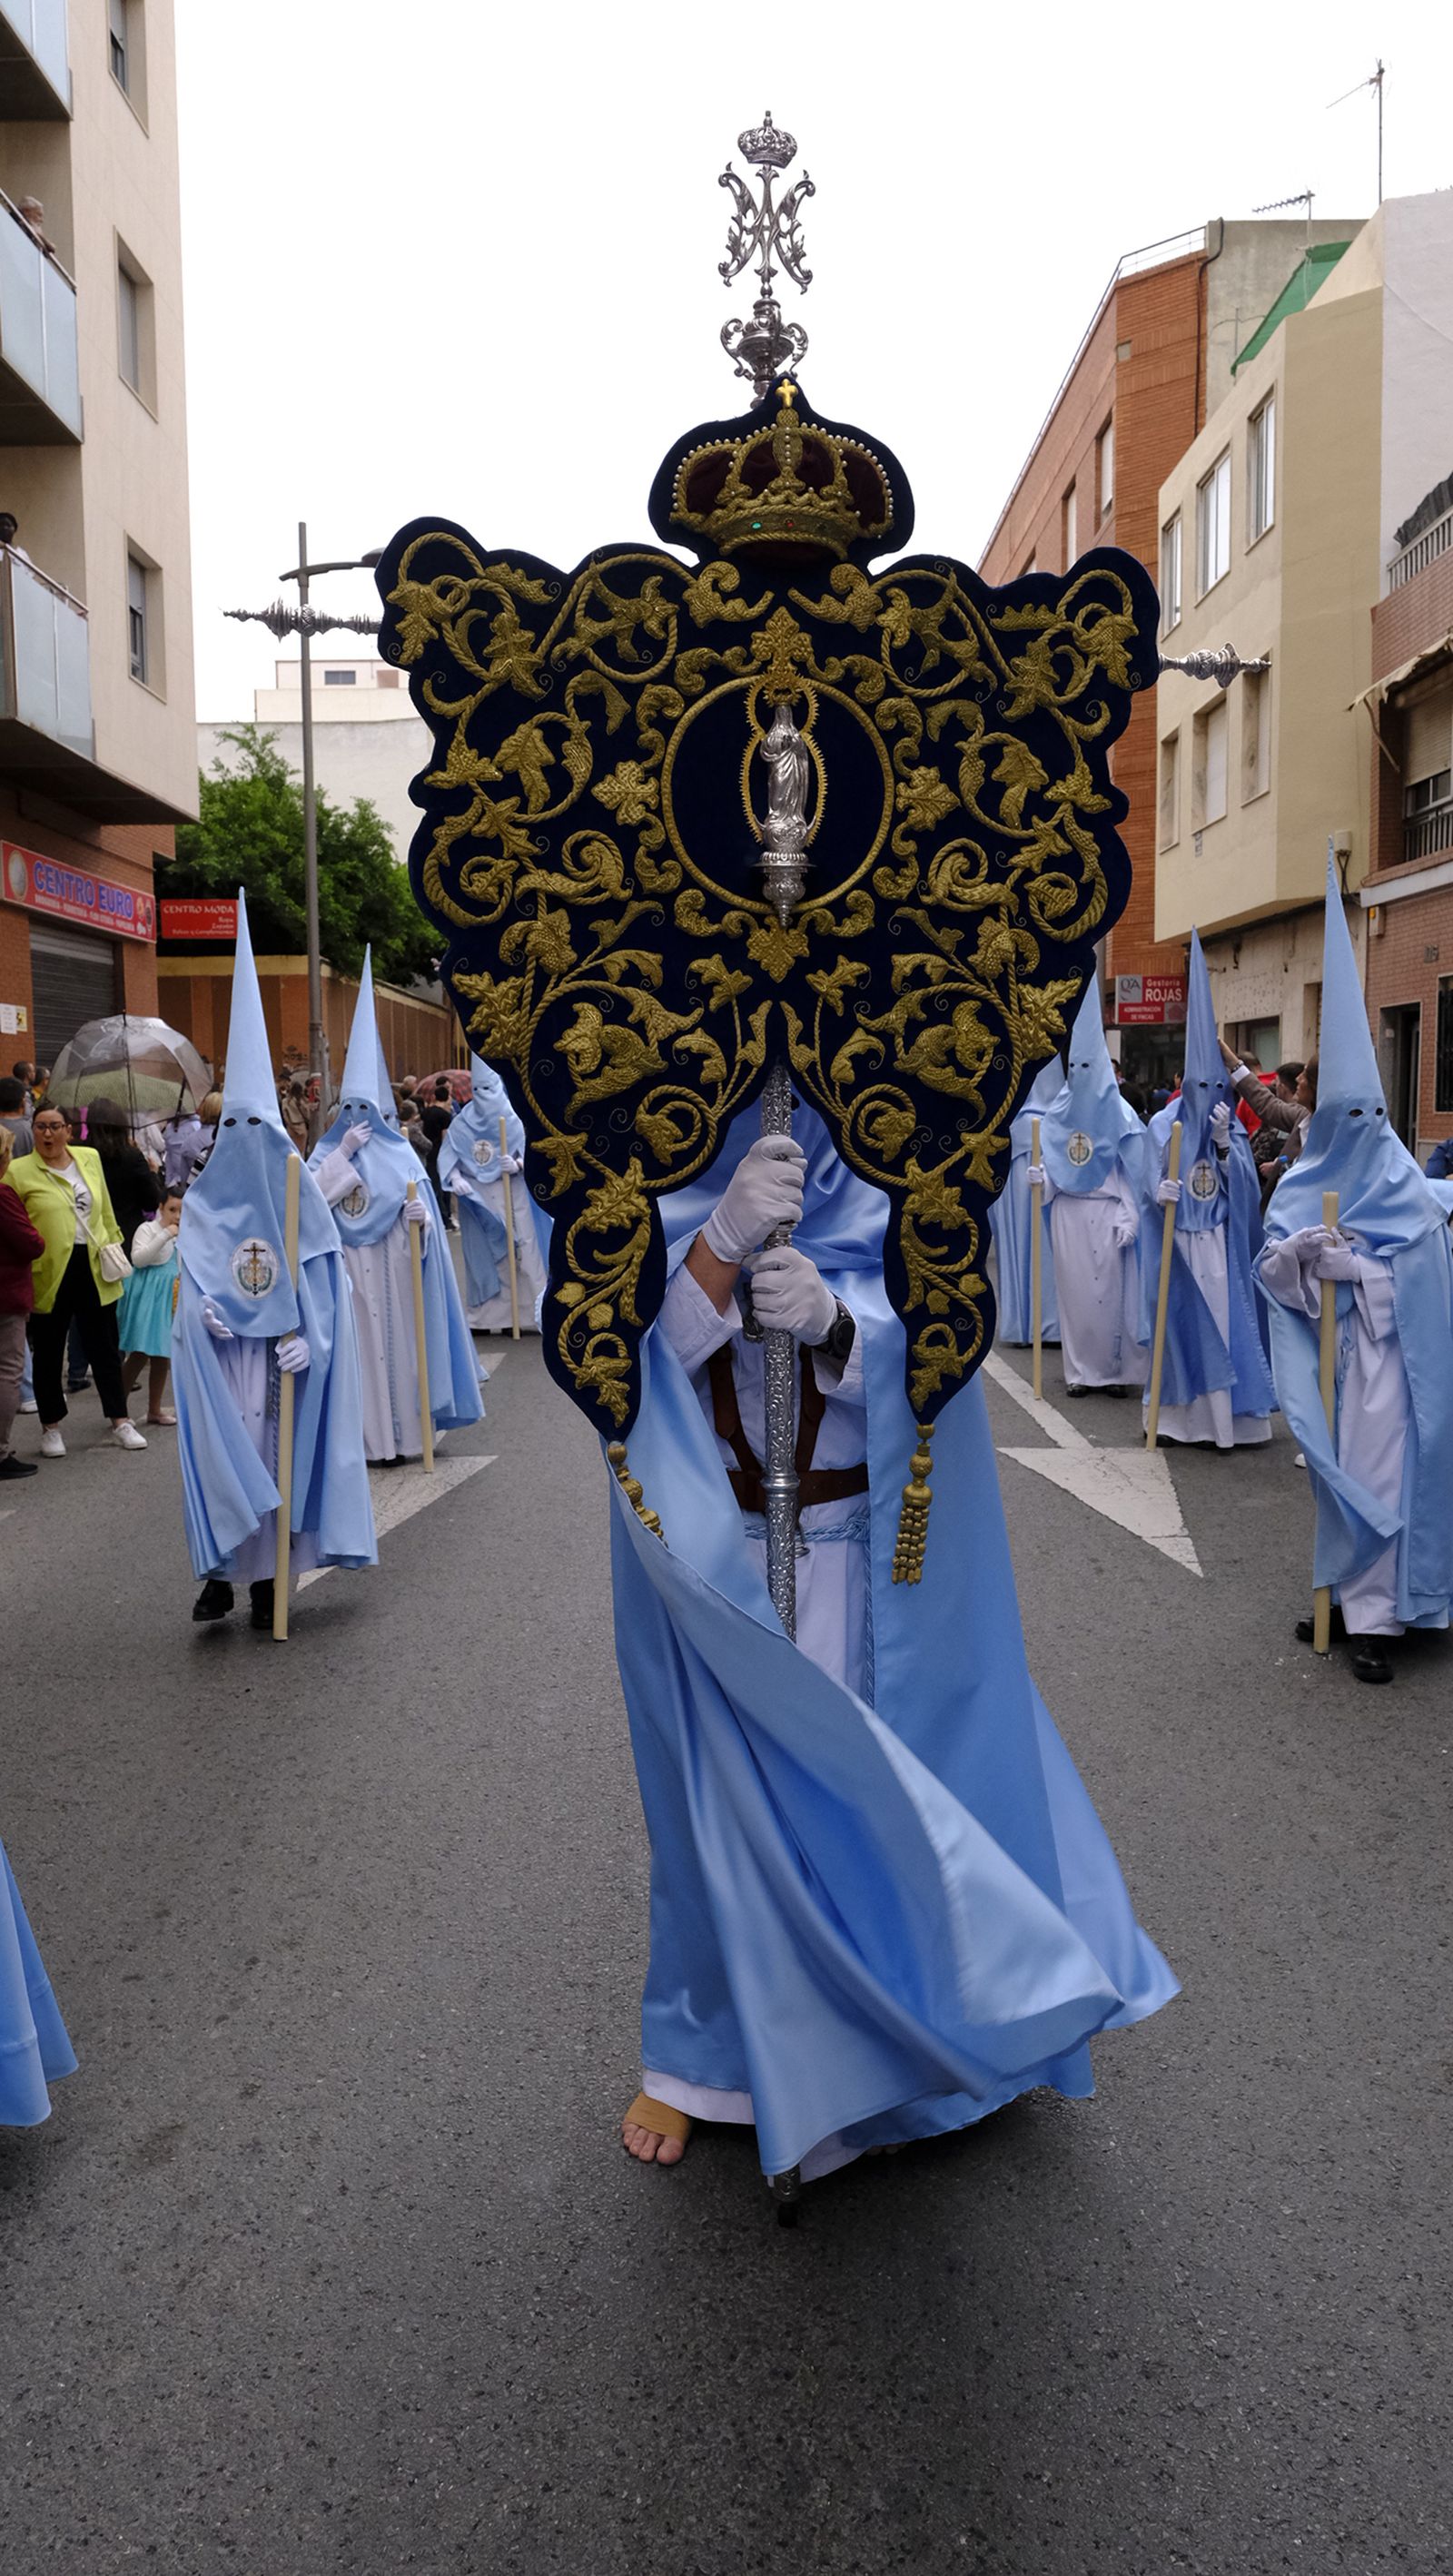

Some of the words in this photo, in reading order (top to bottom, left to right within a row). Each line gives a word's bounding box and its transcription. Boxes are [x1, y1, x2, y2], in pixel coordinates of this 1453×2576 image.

[35, 861, 94, 907] CENTRO
[99, 884, 133, 919] EURO
[163, 905, 203, 913] CENTRO
[204, 905, 234, 913] MODA
[1145, 988, 1182, 1002] ROJAS
